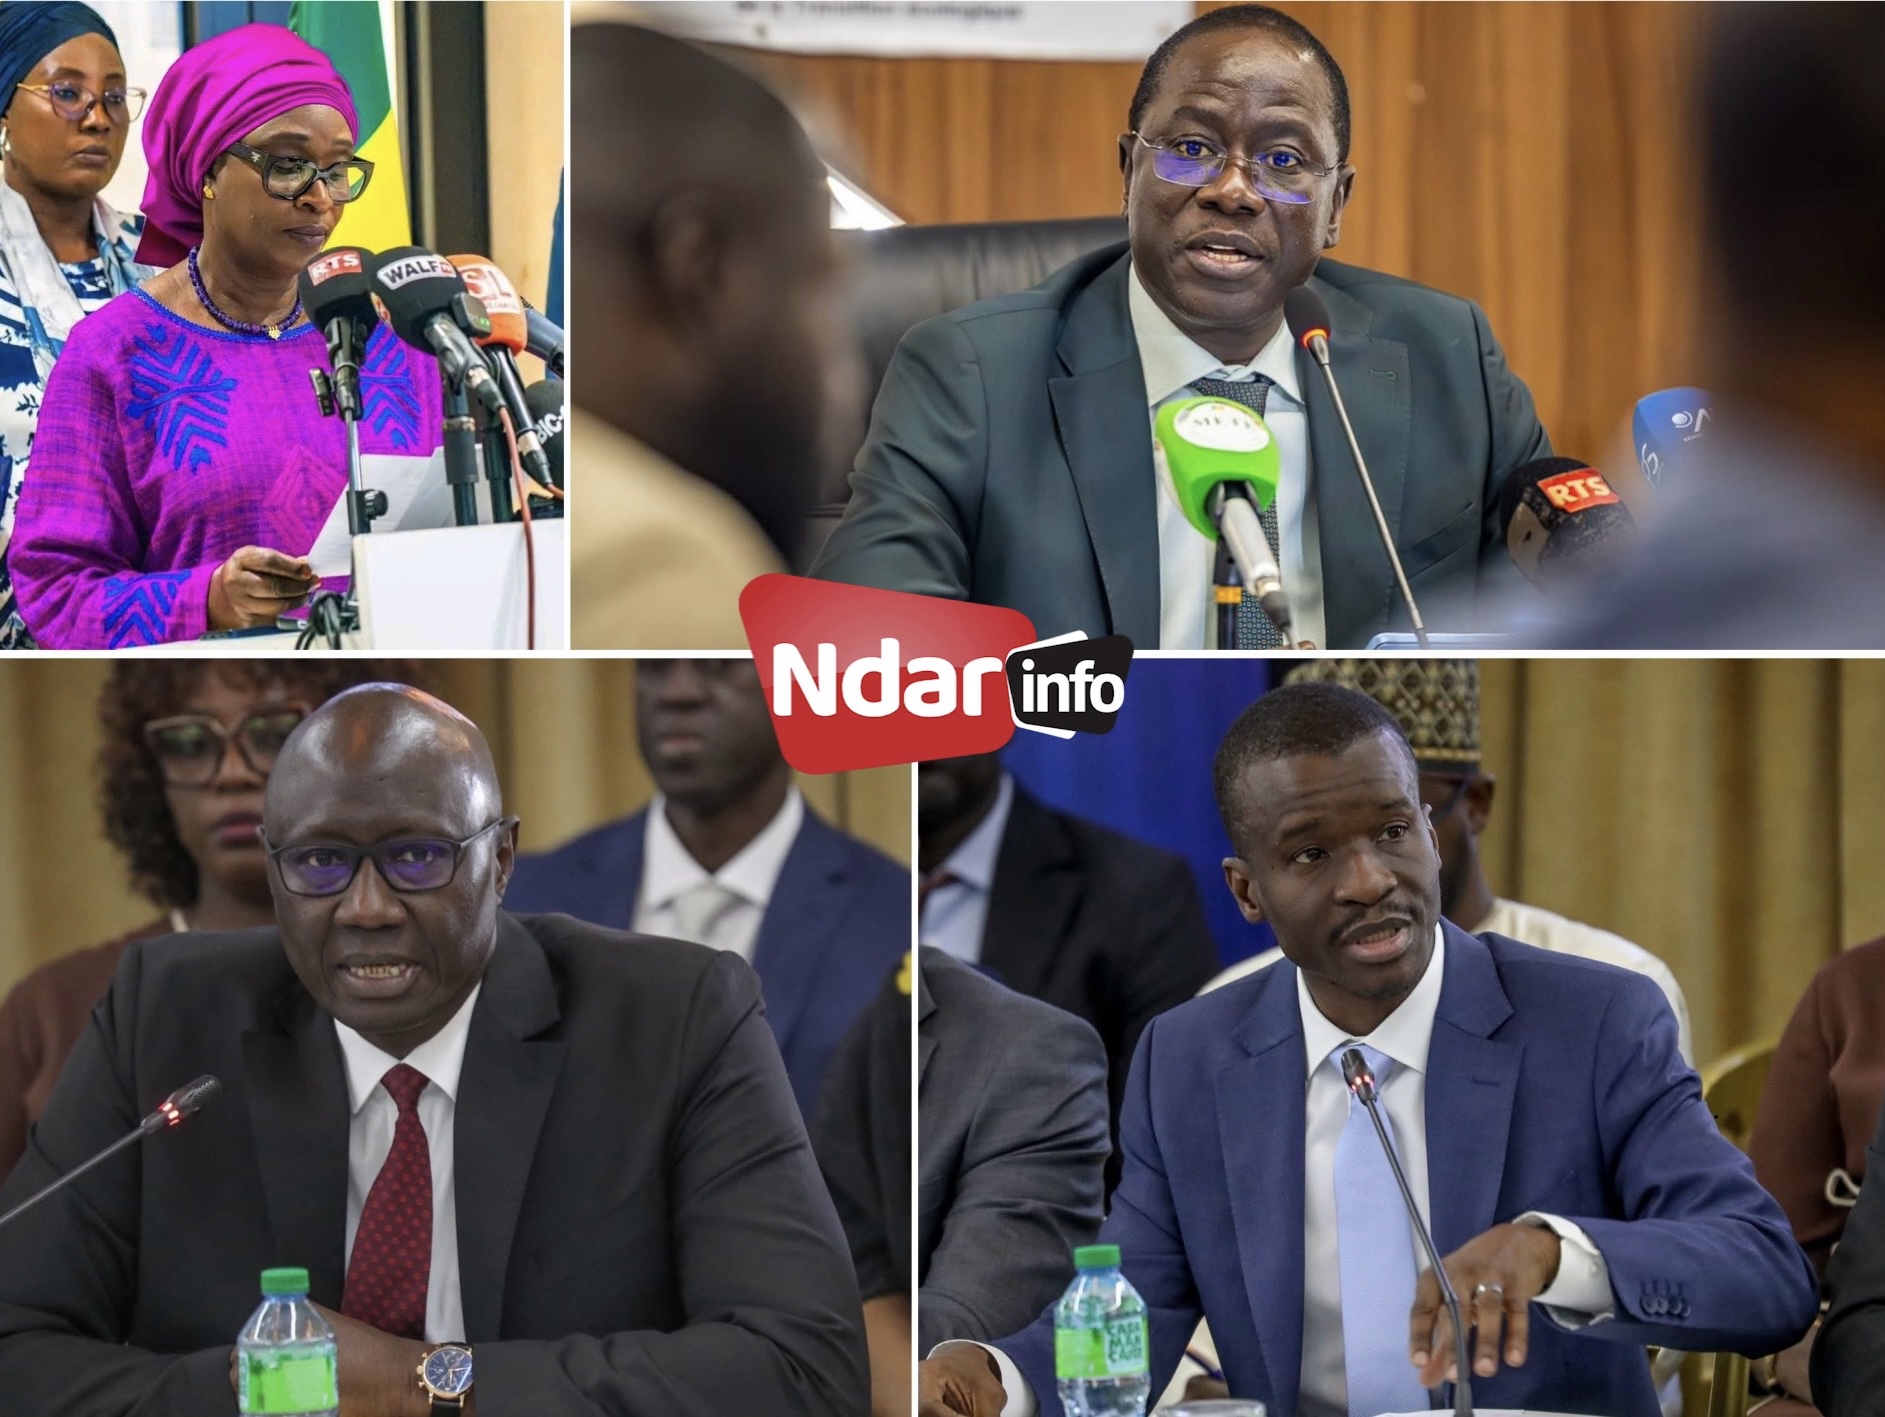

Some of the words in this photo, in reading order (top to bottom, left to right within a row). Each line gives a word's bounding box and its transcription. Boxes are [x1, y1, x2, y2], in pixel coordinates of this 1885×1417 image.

[311, 253, 360, 279] RTS
[384, 260, 439, 284] WALF
[1547, 476, 1611, 506] RTS
